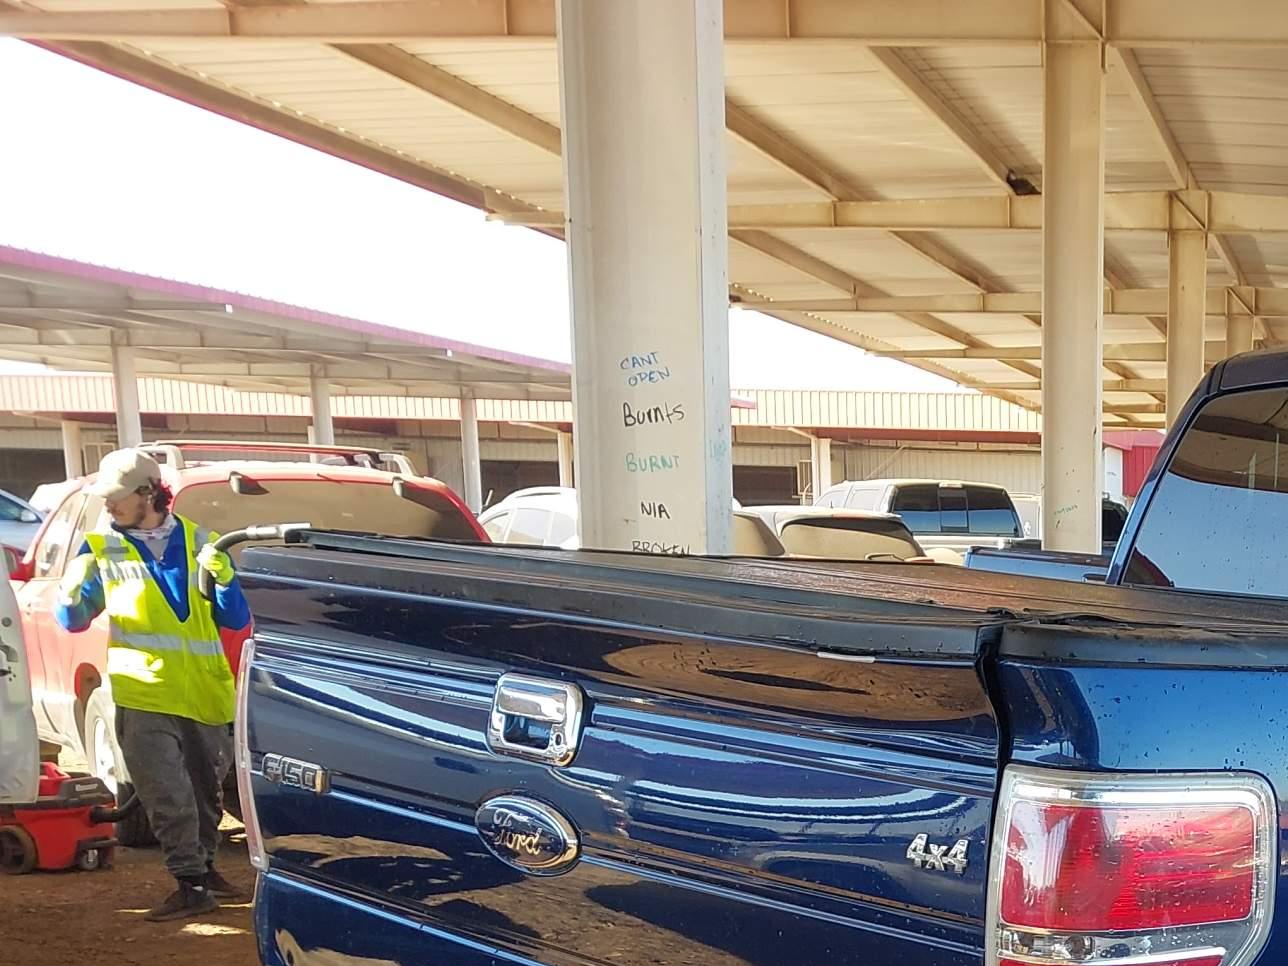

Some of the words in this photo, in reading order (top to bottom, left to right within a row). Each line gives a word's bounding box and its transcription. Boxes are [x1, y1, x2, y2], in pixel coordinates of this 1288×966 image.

[620, 352, 660, 370] CANT
[628, 367, 671, 387] OPEN
[625, 453, 681, 473] BURNT
[632, 540, 690, 556] BROKEN
[492, 806, 543, 856] Ford
